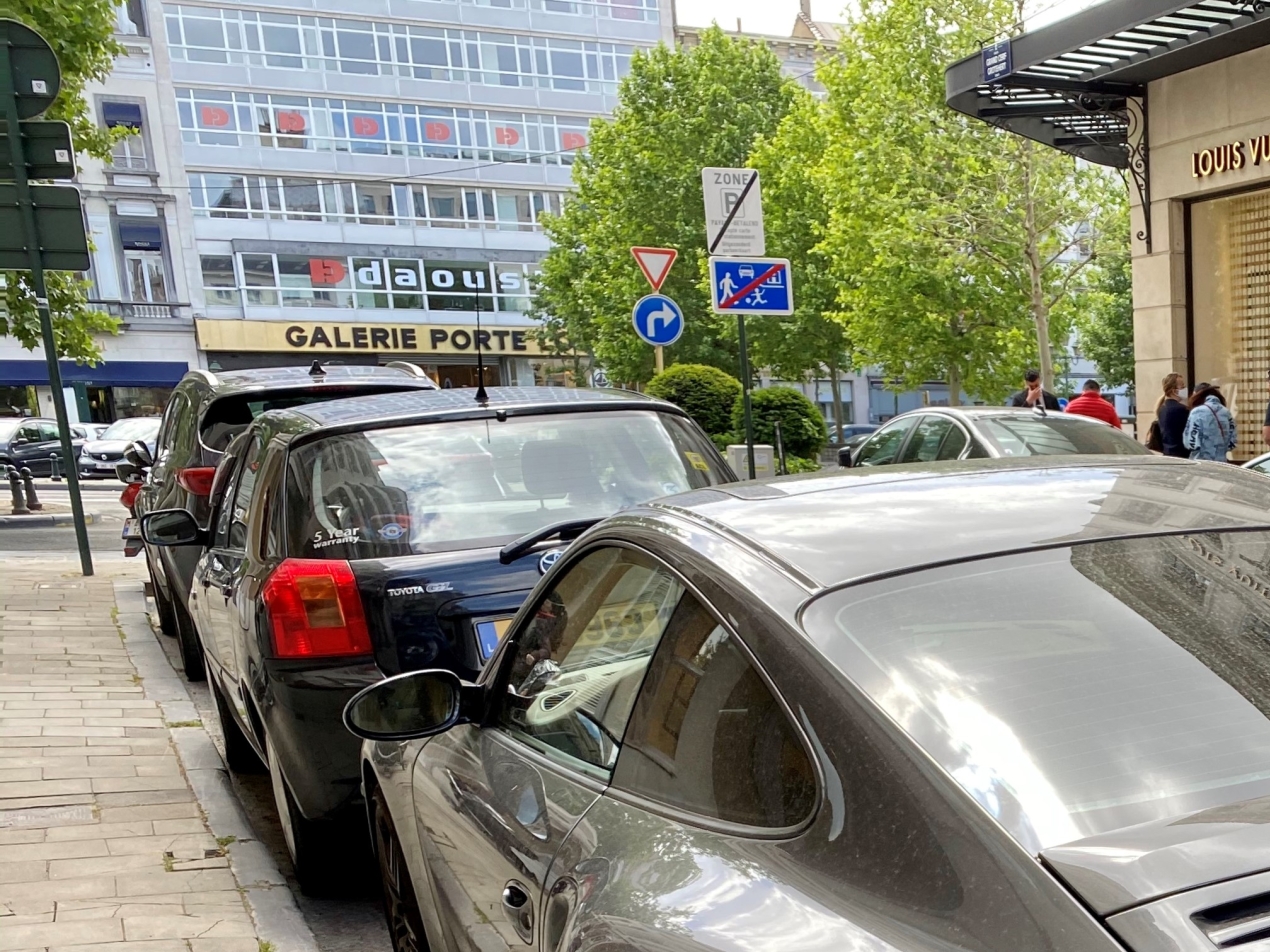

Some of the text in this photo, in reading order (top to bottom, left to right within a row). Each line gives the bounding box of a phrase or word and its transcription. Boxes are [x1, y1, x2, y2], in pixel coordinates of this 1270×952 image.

[1192, 141, 1246, 178] LOUIS
[714, 173, 749, 185] ZONE
[358, 260, 545, 290] daous
[285, 325, 417, 349] GALERIE
[430, 328, 527, 350] PORTE
[313, 535, 360, 549] warranty
[314, 527, 360, 543] 5 Year
[387, 585, 425, 597] TOYOTA
